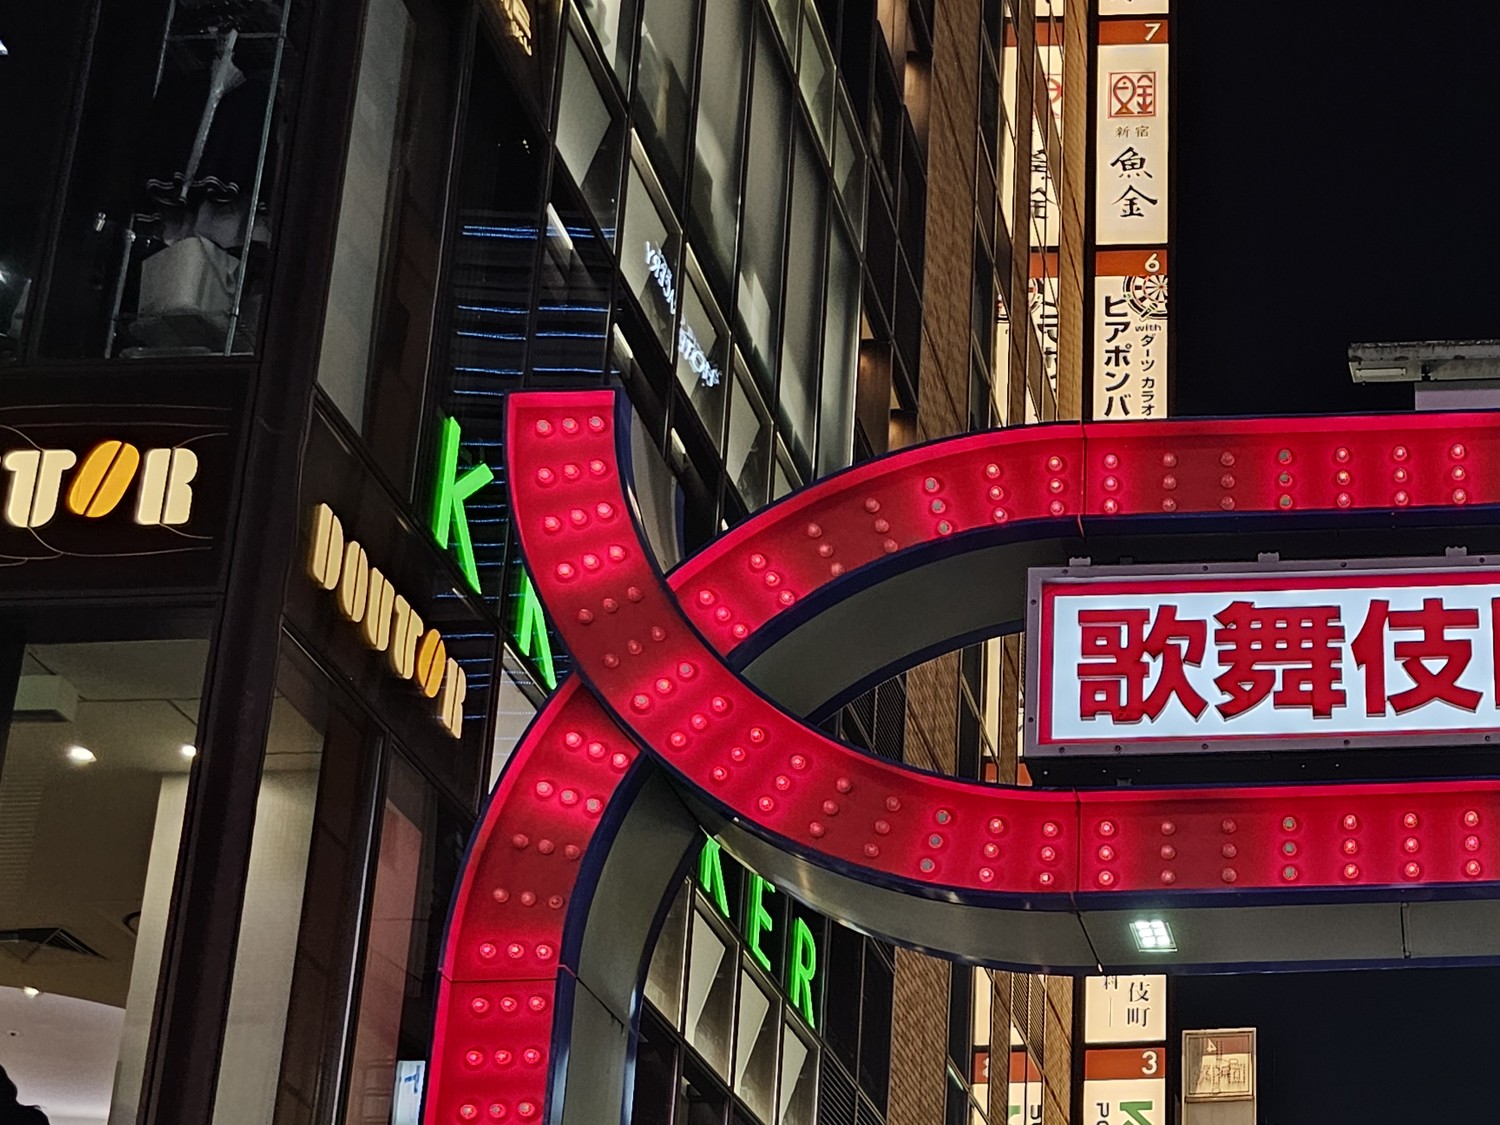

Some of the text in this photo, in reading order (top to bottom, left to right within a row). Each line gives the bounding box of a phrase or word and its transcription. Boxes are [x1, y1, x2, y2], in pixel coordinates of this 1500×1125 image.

[1144, 23, 1161, 41] 7
[1115, 125, 1150, 138] 新宿
[1110, 146, 1158, 218] 魚金
[1144, 253, 1160, 272] 6
[311, 502, 467, 739] DOUTOR
[1141, 1051, 1157, 1075] 3
